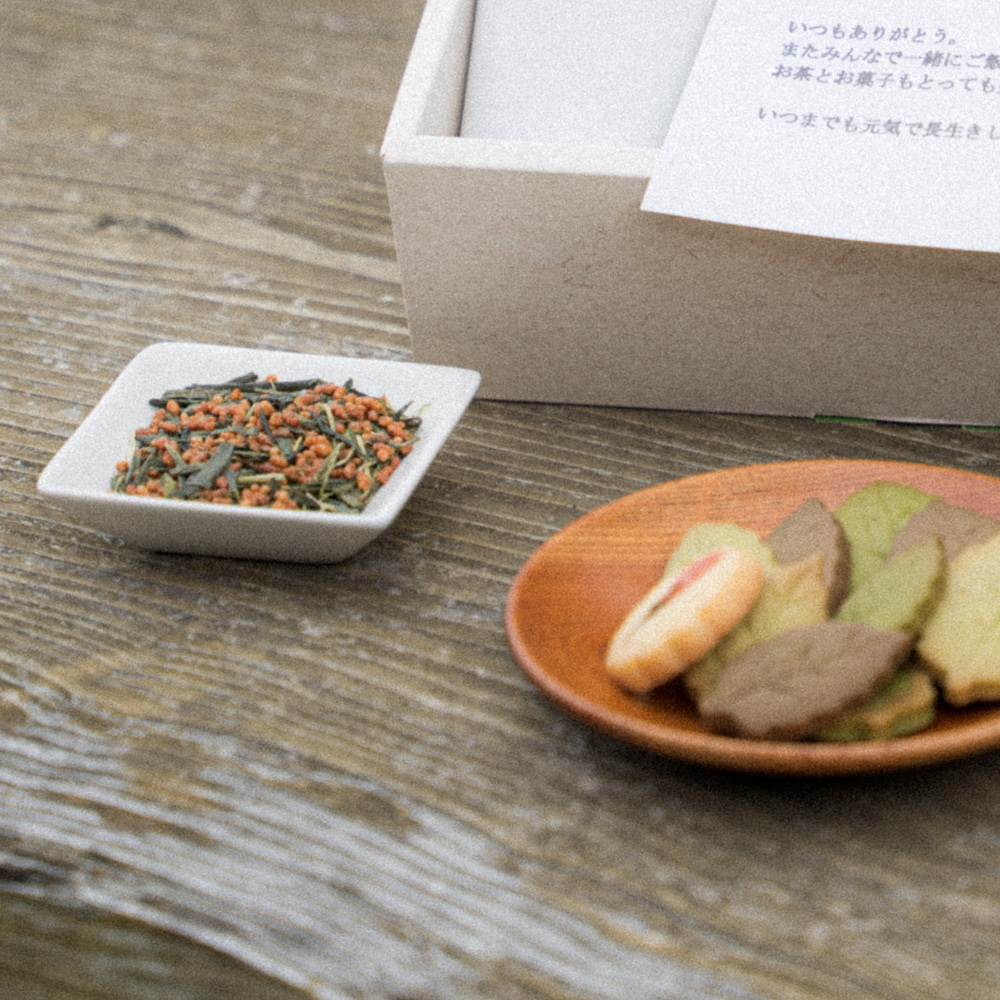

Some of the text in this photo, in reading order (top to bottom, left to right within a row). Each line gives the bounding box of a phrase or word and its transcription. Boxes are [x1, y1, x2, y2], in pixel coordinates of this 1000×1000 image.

[788, 21, 956, 45] いつもありがとう。
